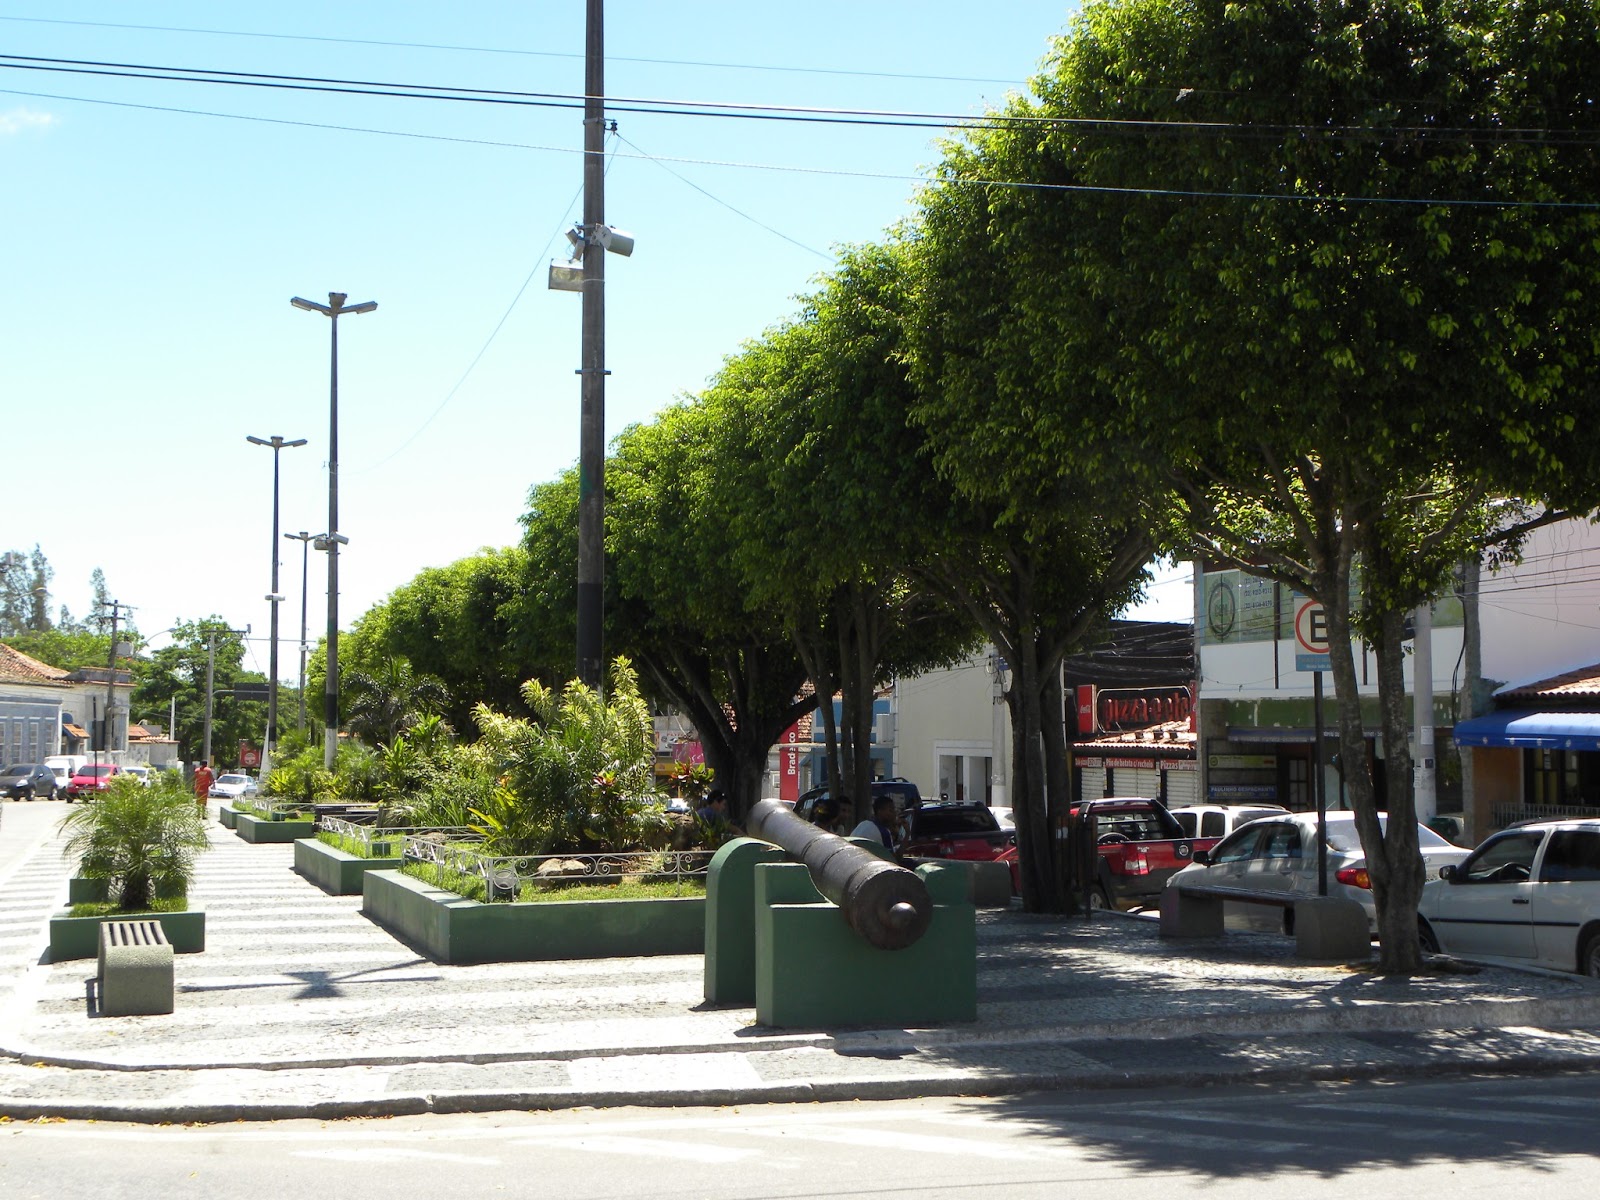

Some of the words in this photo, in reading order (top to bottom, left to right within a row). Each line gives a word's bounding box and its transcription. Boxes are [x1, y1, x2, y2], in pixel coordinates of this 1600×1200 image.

[1310, 610, 1329, 643] E
[788, 732, 796, 775] Bradeco
[1160, 760, 1178, 770] Pizzas
